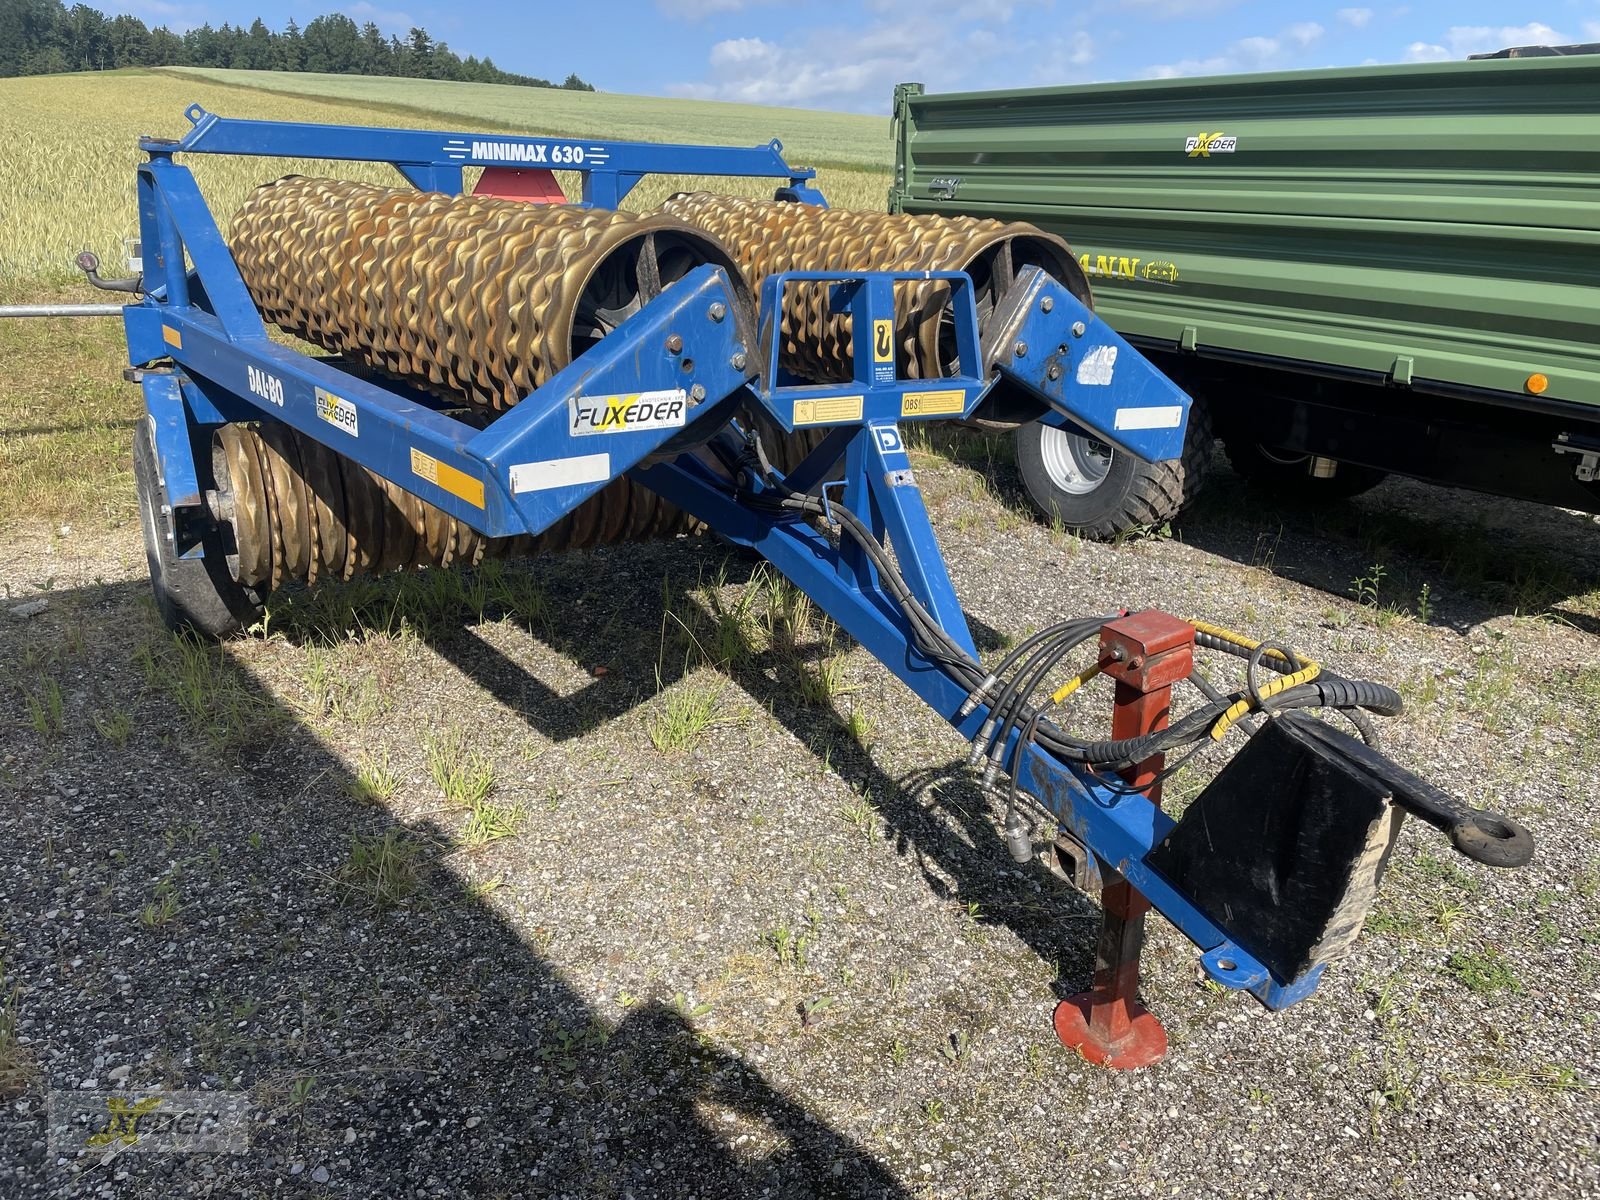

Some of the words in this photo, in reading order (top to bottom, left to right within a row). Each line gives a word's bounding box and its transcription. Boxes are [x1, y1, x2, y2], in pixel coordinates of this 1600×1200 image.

[471, 141, 547, 162] MINIMAX
[551, 145, 584, 164] 630
[1186, 137, 1236, 152] FLIXEDER
[316, 395, 357, 430] FLIXEDER
[573, 399, 683, 429] FLIXEDER
[904, 398, 921, 411] OBS!
